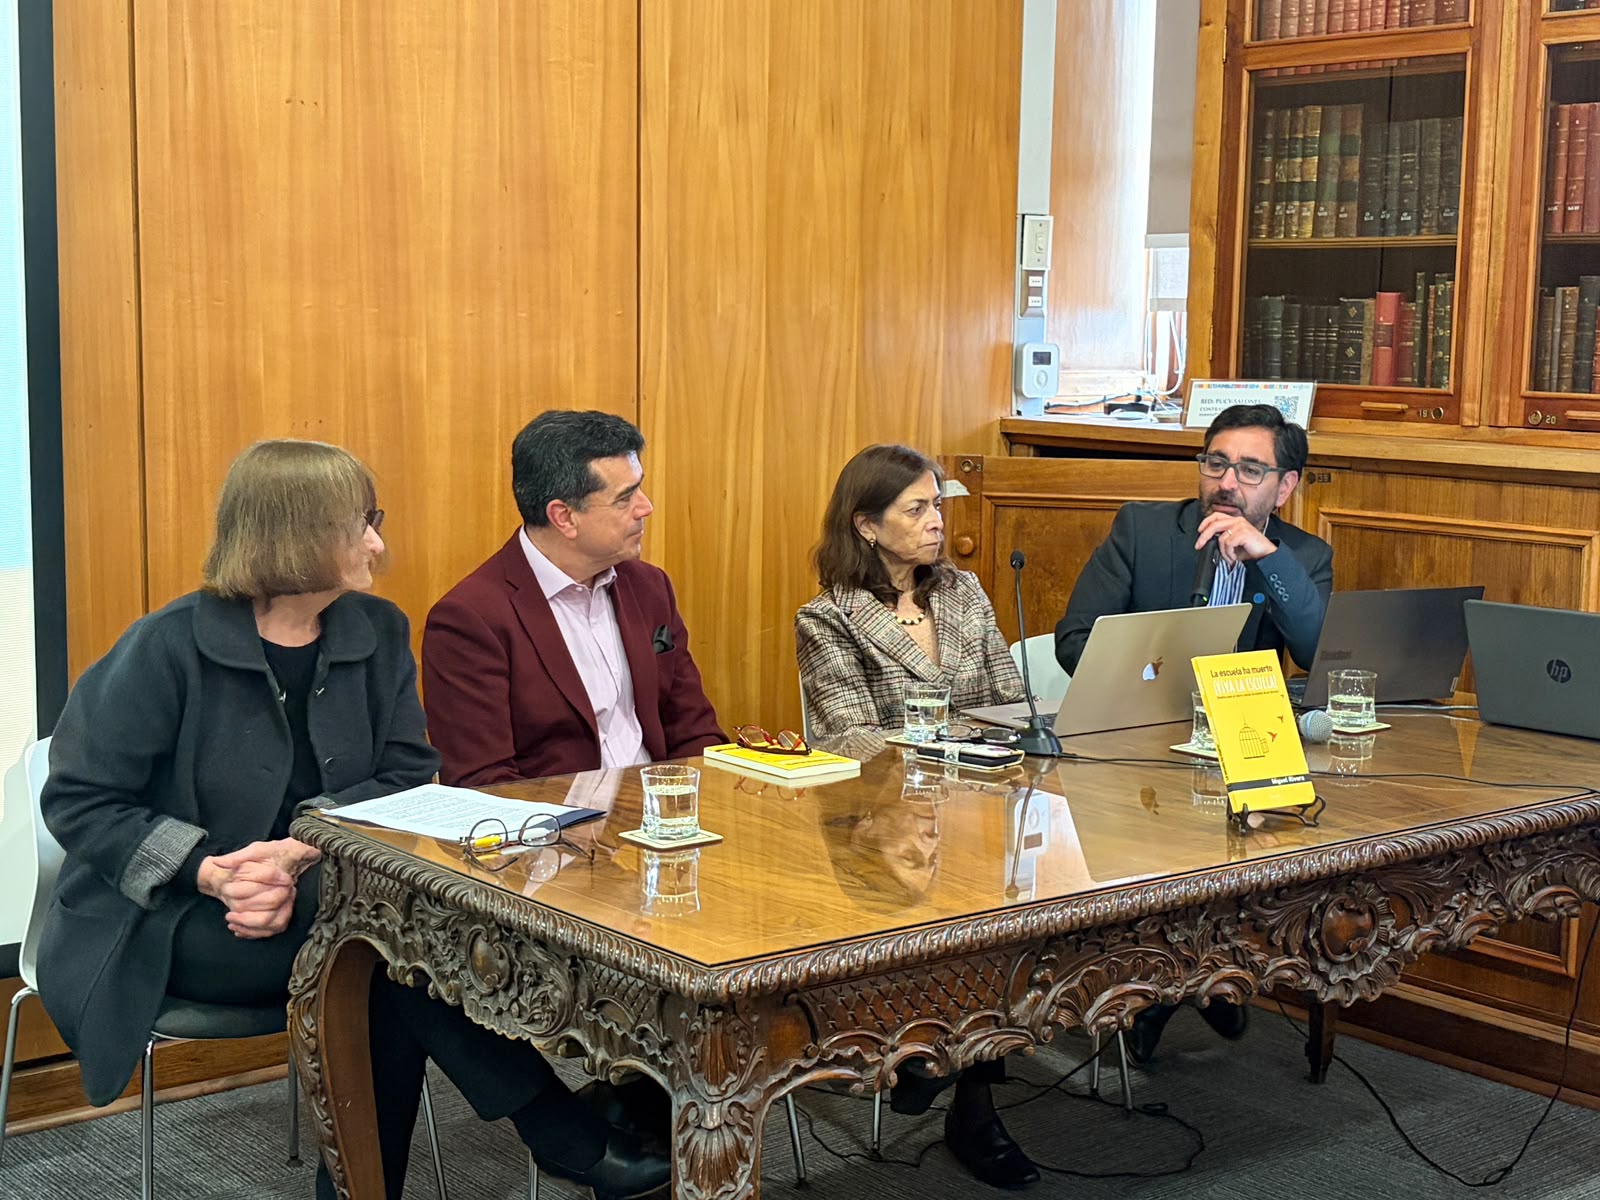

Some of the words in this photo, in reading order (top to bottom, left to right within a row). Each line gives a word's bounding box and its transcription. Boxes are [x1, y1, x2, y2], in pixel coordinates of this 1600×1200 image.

[1545, 414, 1557, 425] 20
[1210, 669, 1219, 678] La
[1219, 667, 1243, 677] escuela
[1242, 666, 1251, 675] ha
[1251, 665, 1273, 674] muerto
[1549, 659, 1570, 683] hp
[1235, 678, 1246, 693] LA
[1271, 776, 1288, 785] Miguel
[1288, 775, 1306, 783] Rivera
